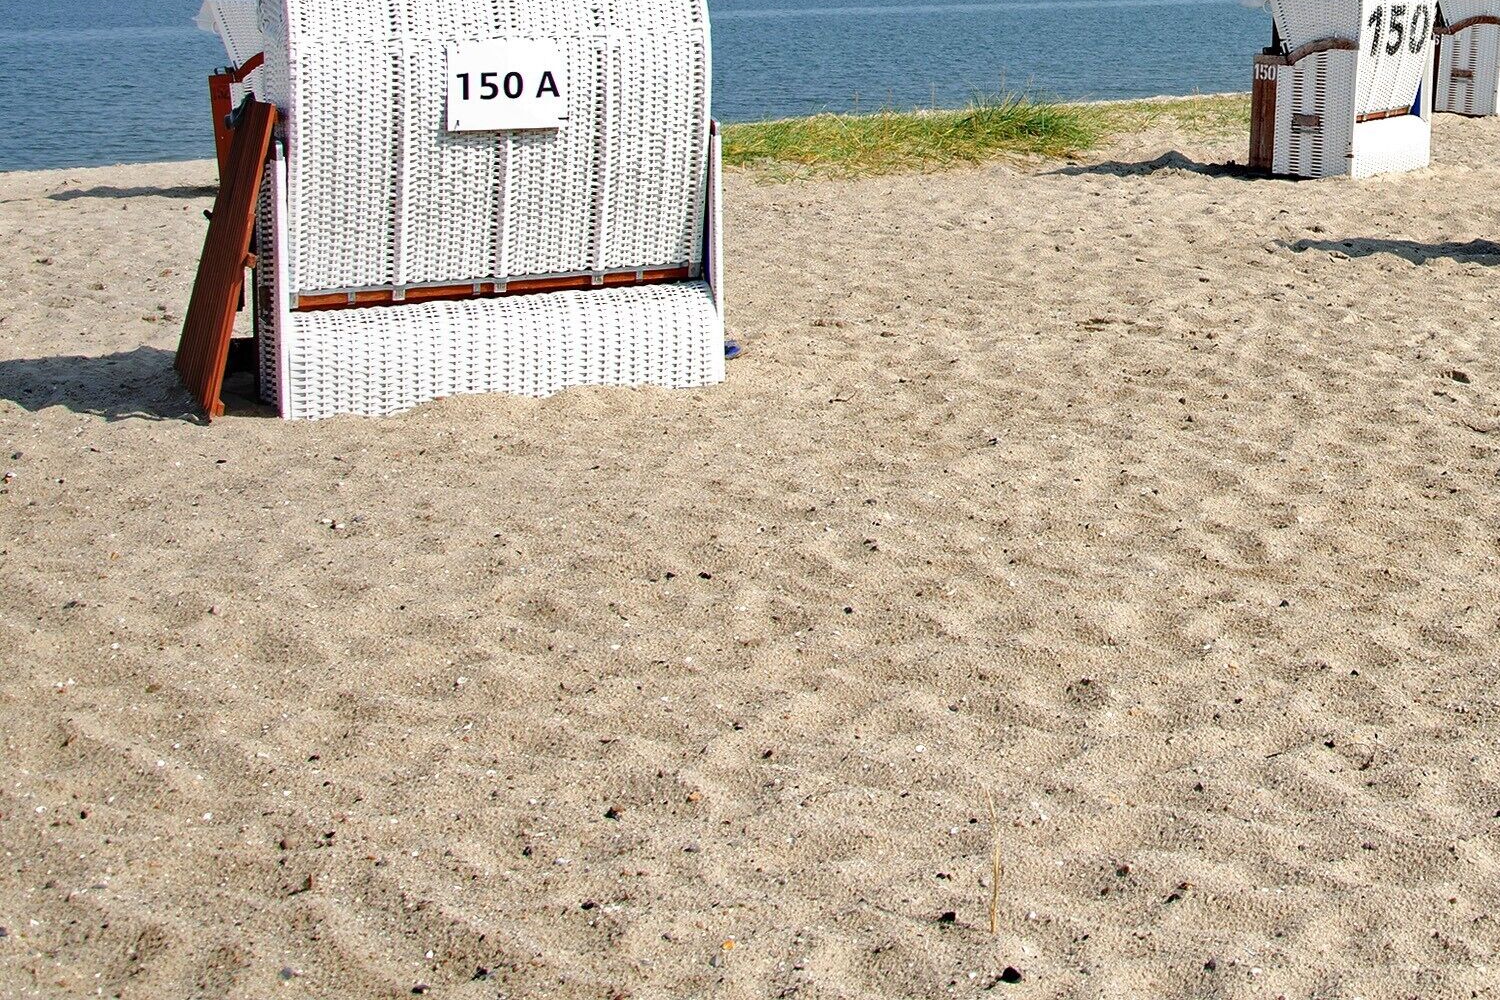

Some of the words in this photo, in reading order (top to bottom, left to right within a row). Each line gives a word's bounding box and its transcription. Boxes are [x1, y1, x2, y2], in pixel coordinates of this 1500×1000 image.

[1368, 4, 1430, 56] 150
[456, 71, 524, 100] 150
[536, 71, 560, 98] A
[1254, 63, 1277, 80] 150
